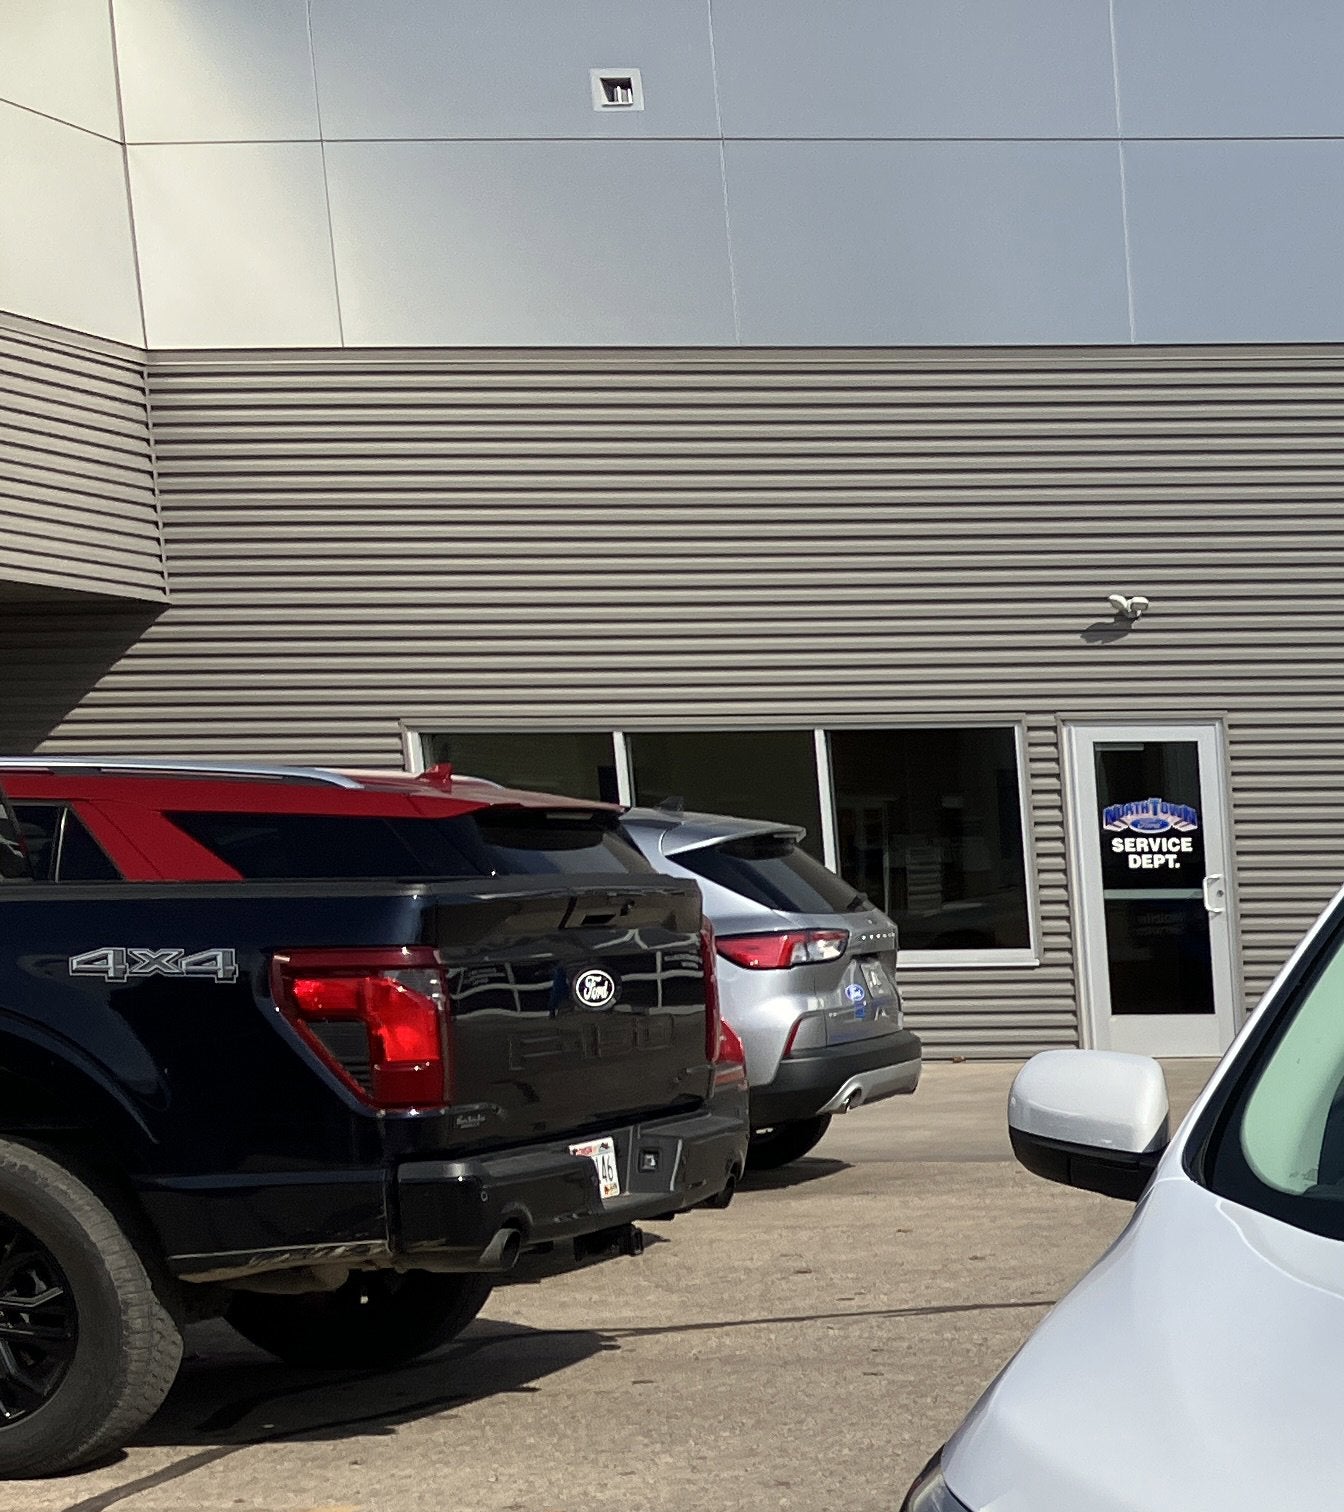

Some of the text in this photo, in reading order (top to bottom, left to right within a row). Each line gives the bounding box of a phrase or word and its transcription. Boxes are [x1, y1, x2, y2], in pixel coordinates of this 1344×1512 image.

[1111, 837, 1193, 853] SERVICE
[1128, 853, 1181, 869] DEPT.
[583, 975, 610, 1000] Ford
